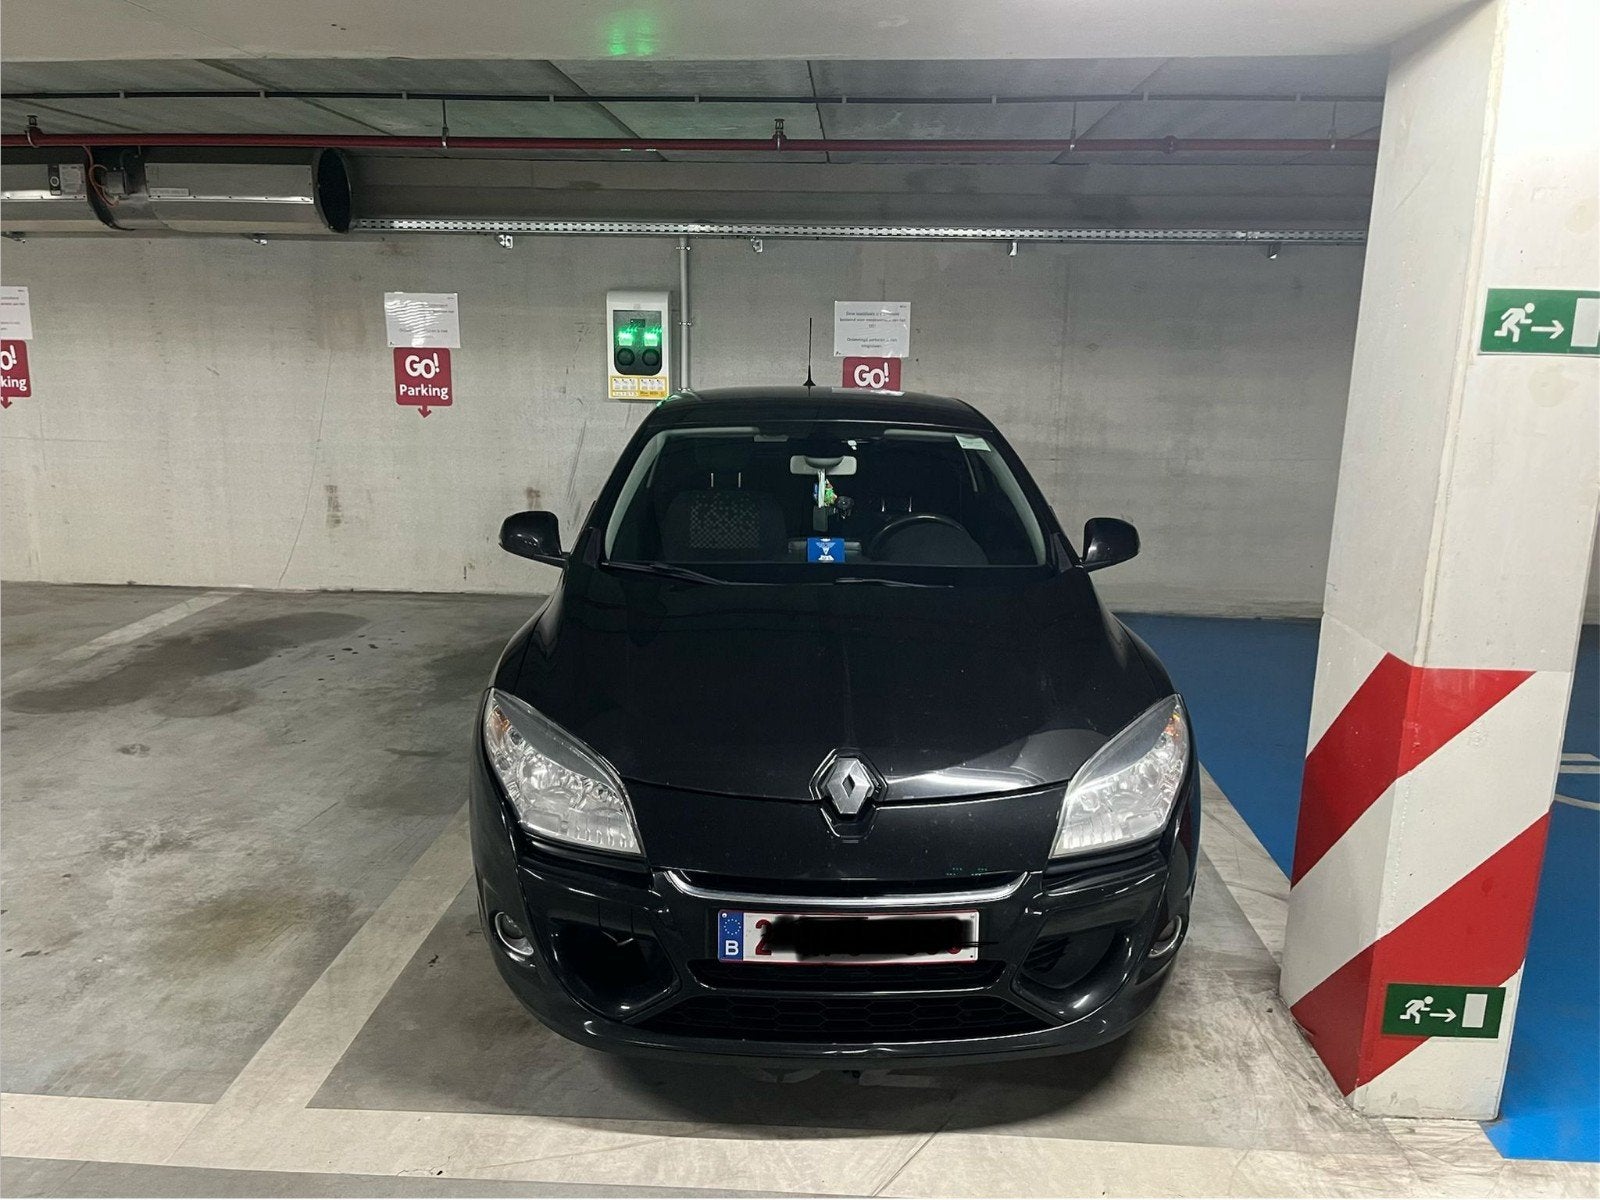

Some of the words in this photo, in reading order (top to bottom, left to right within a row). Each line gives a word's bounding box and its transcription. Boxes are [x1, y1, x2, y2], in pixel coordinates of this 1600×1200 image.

[0, 345, 17, 370] O!
[405, 353, 440, 379] GO!
[0, 376, 27, 391] king
[854, 362, 889, 389] GO!
[400, 384, 449, 400] Parking
[725, 940, 739, 956] B
